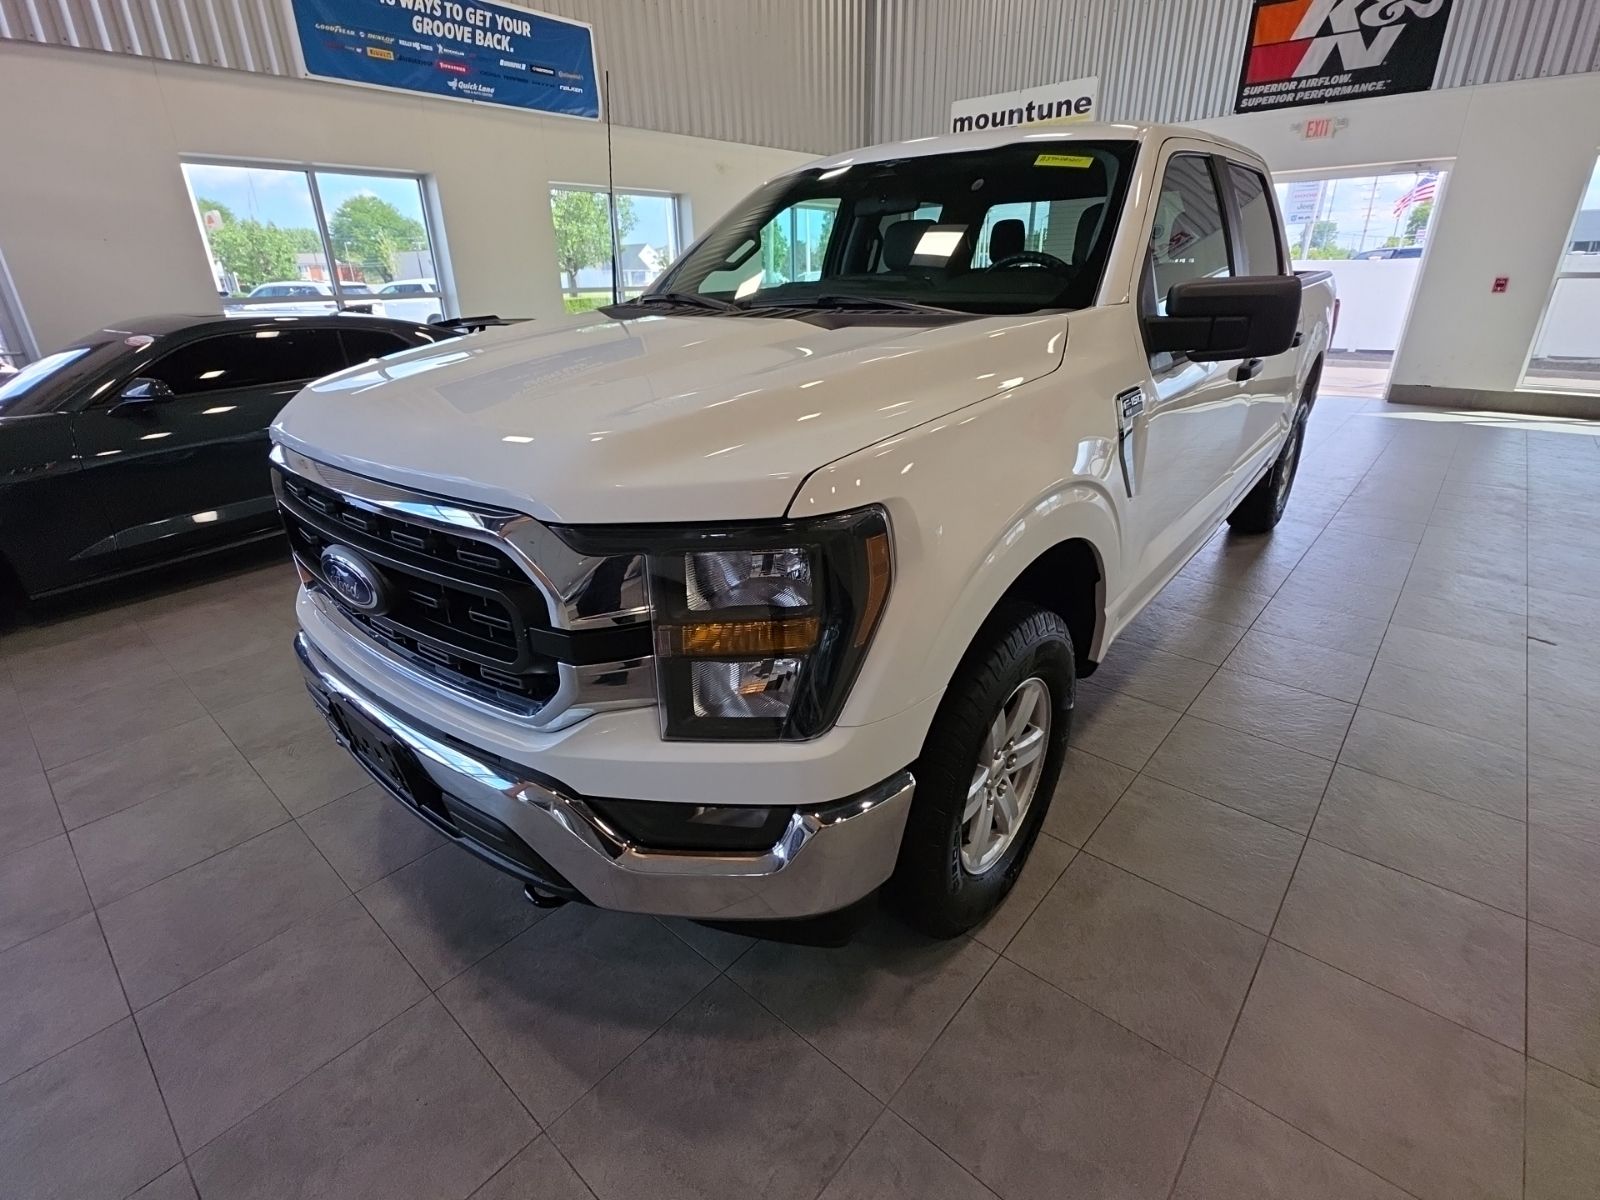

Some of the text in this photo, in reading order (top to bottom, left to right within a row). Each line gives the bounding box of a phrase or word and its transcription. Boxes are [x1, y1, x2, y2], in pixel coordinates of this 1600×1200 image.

[444, 3, 463, 21] TO
[466, 7, 492, 28] GET
[495, 13, 531, 38] YOUR
[412, 15, 514, 52] GROOVE BACK.
[458, 81, 478, 91] Quick
[478, 84, 495, 94] Lane
[1242, 73, 1353, 96] SUPERIOR AIRFLOW.
[1240, 92, 1296, 108] SUPERIOR
[952, 95, 1092, 134] mountune
[1305, 119, 1332, 139] EXIT
